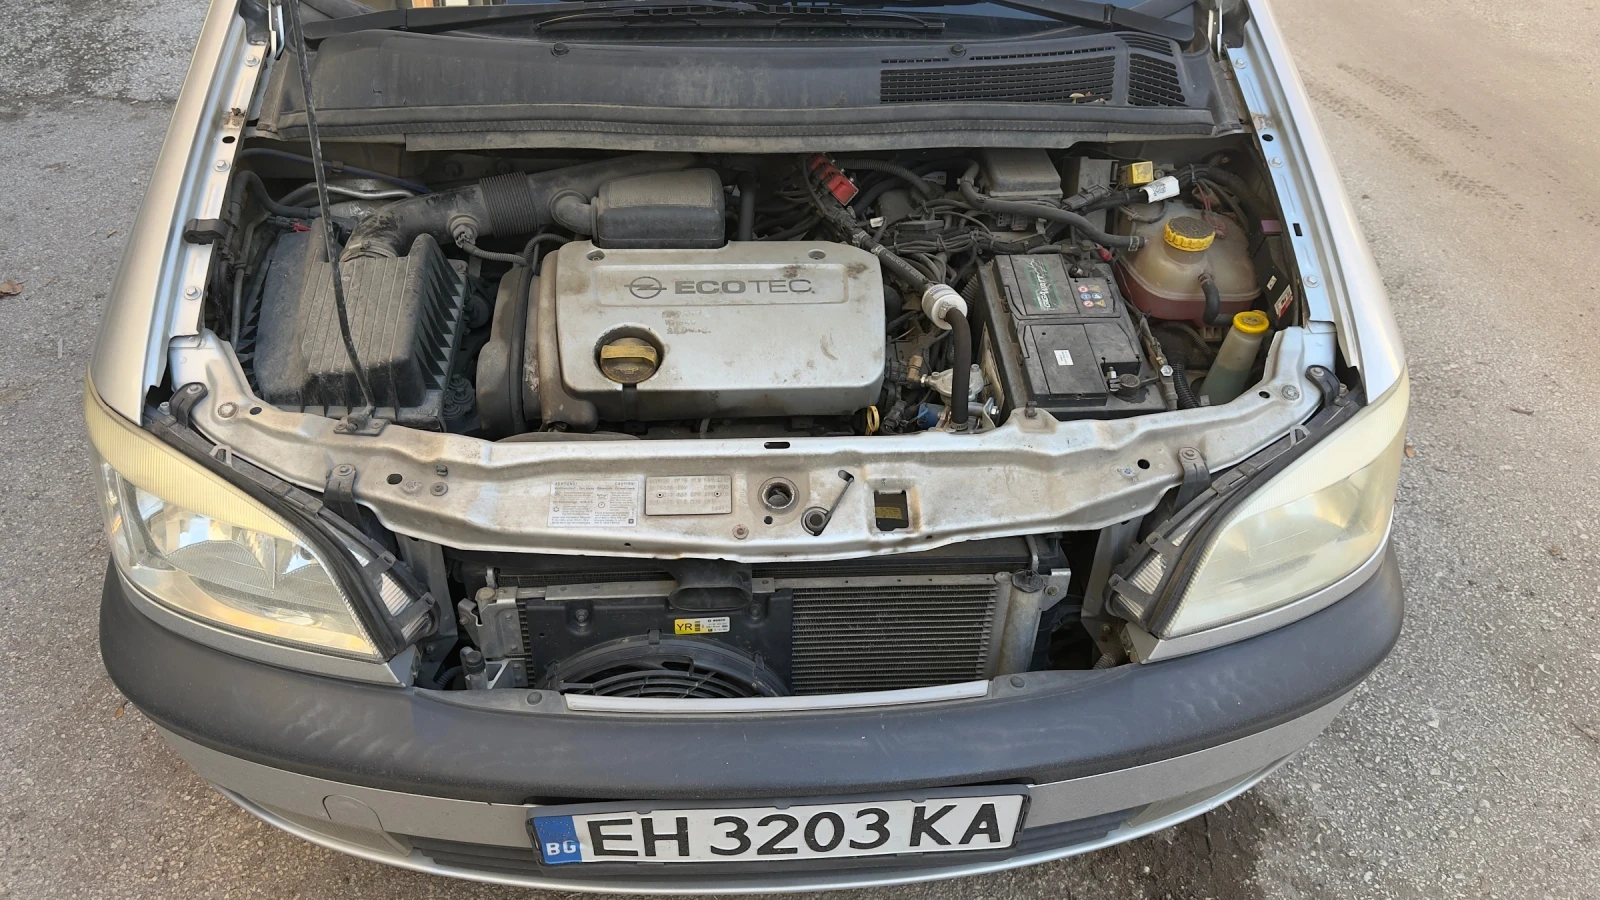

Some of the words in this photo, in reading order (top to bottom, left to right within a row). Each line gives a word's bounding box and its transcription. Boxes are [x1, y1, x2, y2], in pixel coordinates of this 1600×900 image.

[674, 279, 812, 295] ECOTEC
[676, 623, 693, 631] YR
[587, 817, 690, 856] EH
[710, 807, 891, 856] 3203
[909, 803, 1001, 847] KA
[545, 840, 577, 856] BG
